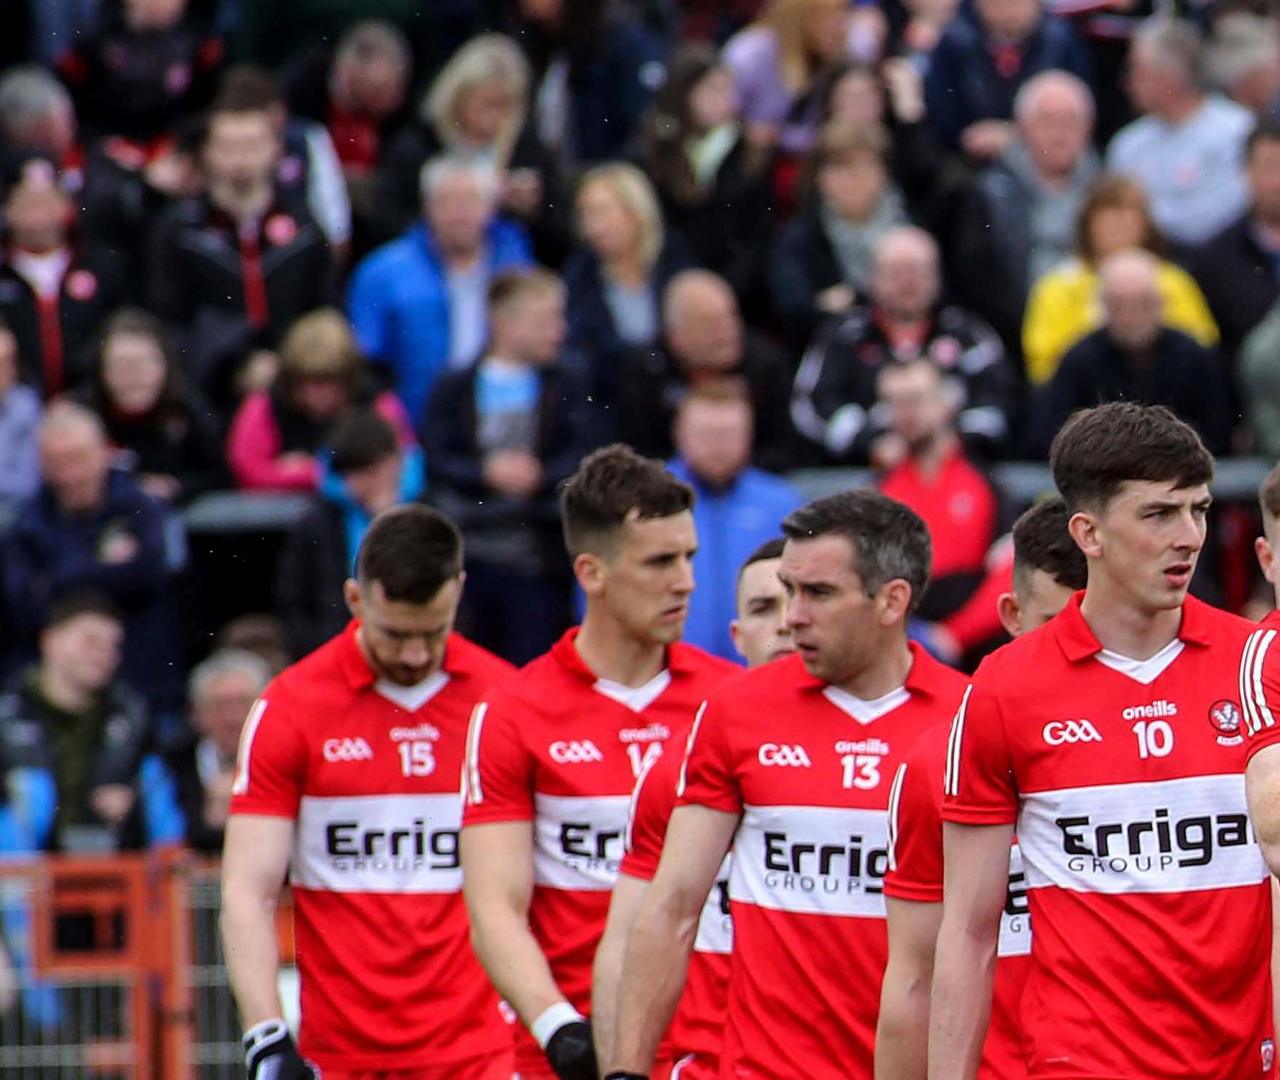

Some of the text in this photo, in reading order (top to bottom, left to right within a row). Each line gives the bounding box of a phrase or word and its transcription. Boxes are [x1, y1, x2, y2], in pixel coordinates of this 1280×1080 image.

[1132, 720, 1175, 760] 10
[400, 742, 436, 777] 15
[841, 754, 881, 789] 13
[1067, 856, 1174, 873] GROUP
[764, 873, 859, 895] GROUP
